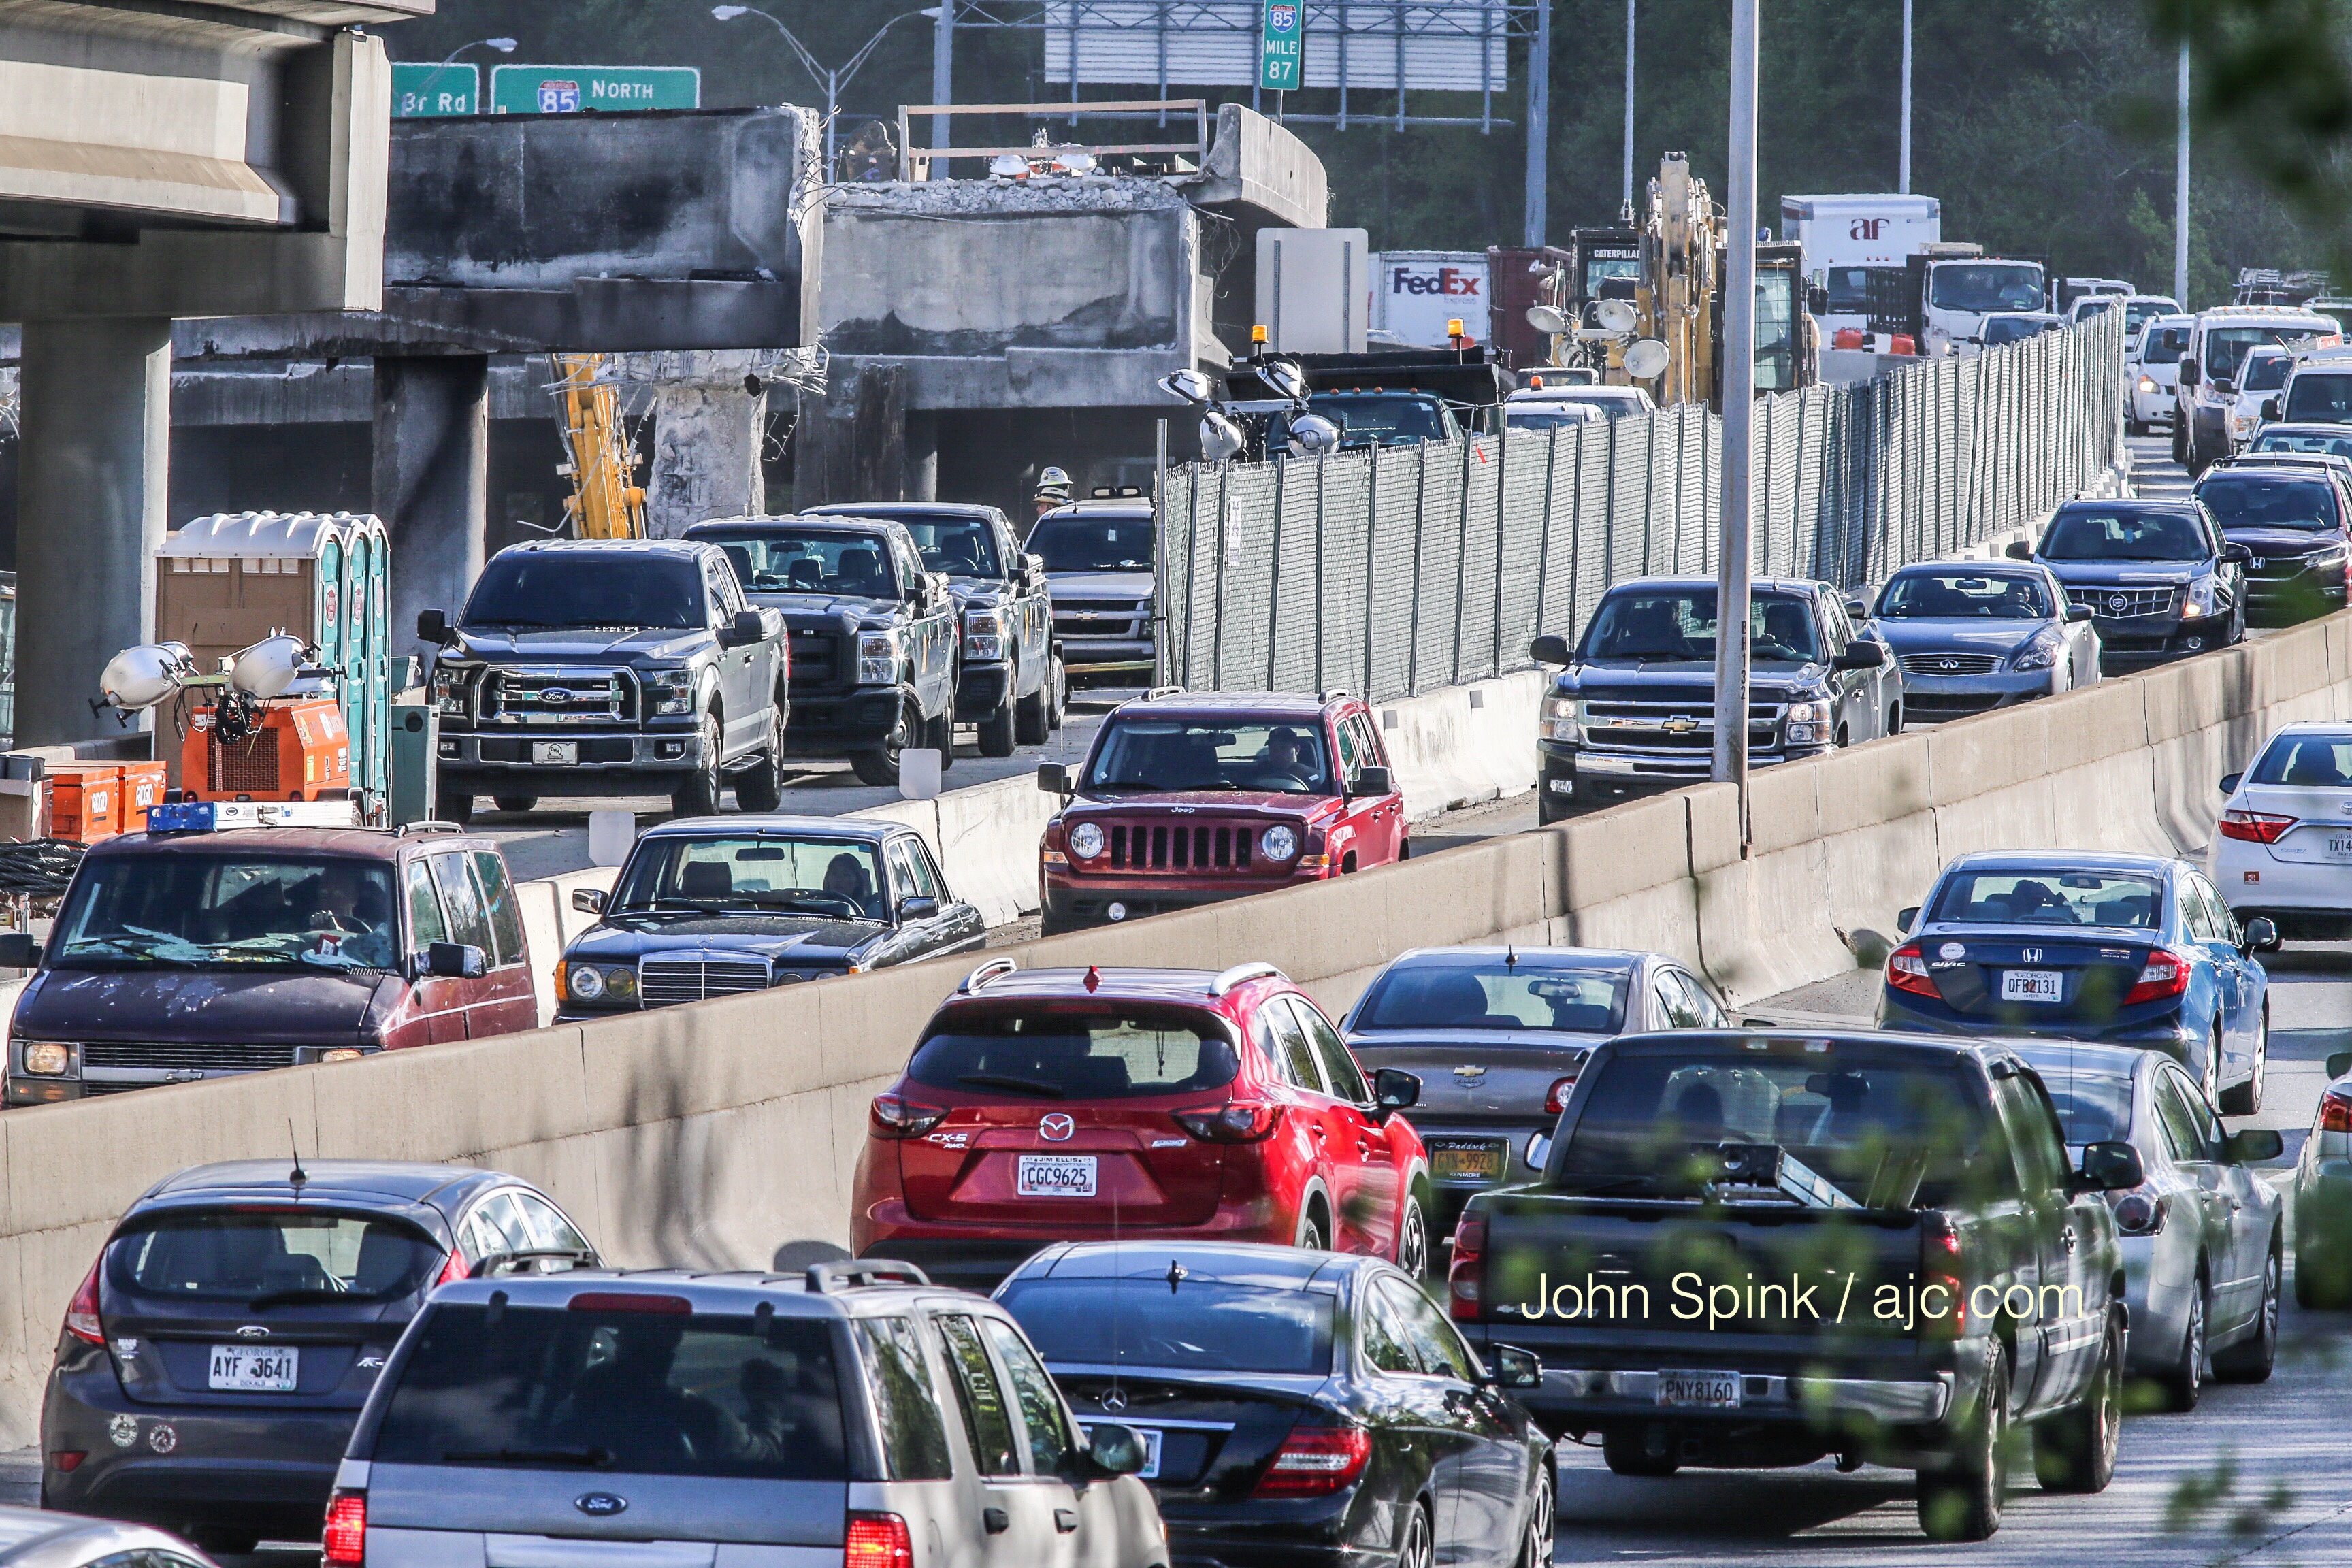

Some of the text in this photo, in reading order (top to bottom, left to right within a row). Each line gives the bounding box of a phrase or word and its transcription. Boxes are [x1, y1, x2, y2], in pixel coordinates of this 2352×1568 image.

[1272, 12, 1293, 27] 85
[1266, 40, 1297, 54] MILE
[1269, 61, 1292, 80] 87
[592, 80, 653, 99] NORTH
[438, 92, 466, 112] Rd
[542, 91, 576, 113] 85
[1850, 218, 1890, 240] af
[1393, 267, 1480, 295] FedEx
[546, 691, 565, 700] Ford
[2329, 840, 2352, 852] TX14
[928, 1134, 968, 1143] CX-5
[1448, 1142, 1486, 1151] Paddock
[1028, 1167, 1087, 1186] CGC9625
[213, 1356, 291, 1378] AYF 3641
[1666, 1380, 1733, 1401] PNY8160
[588, 1497, 614, 1509] Ford
